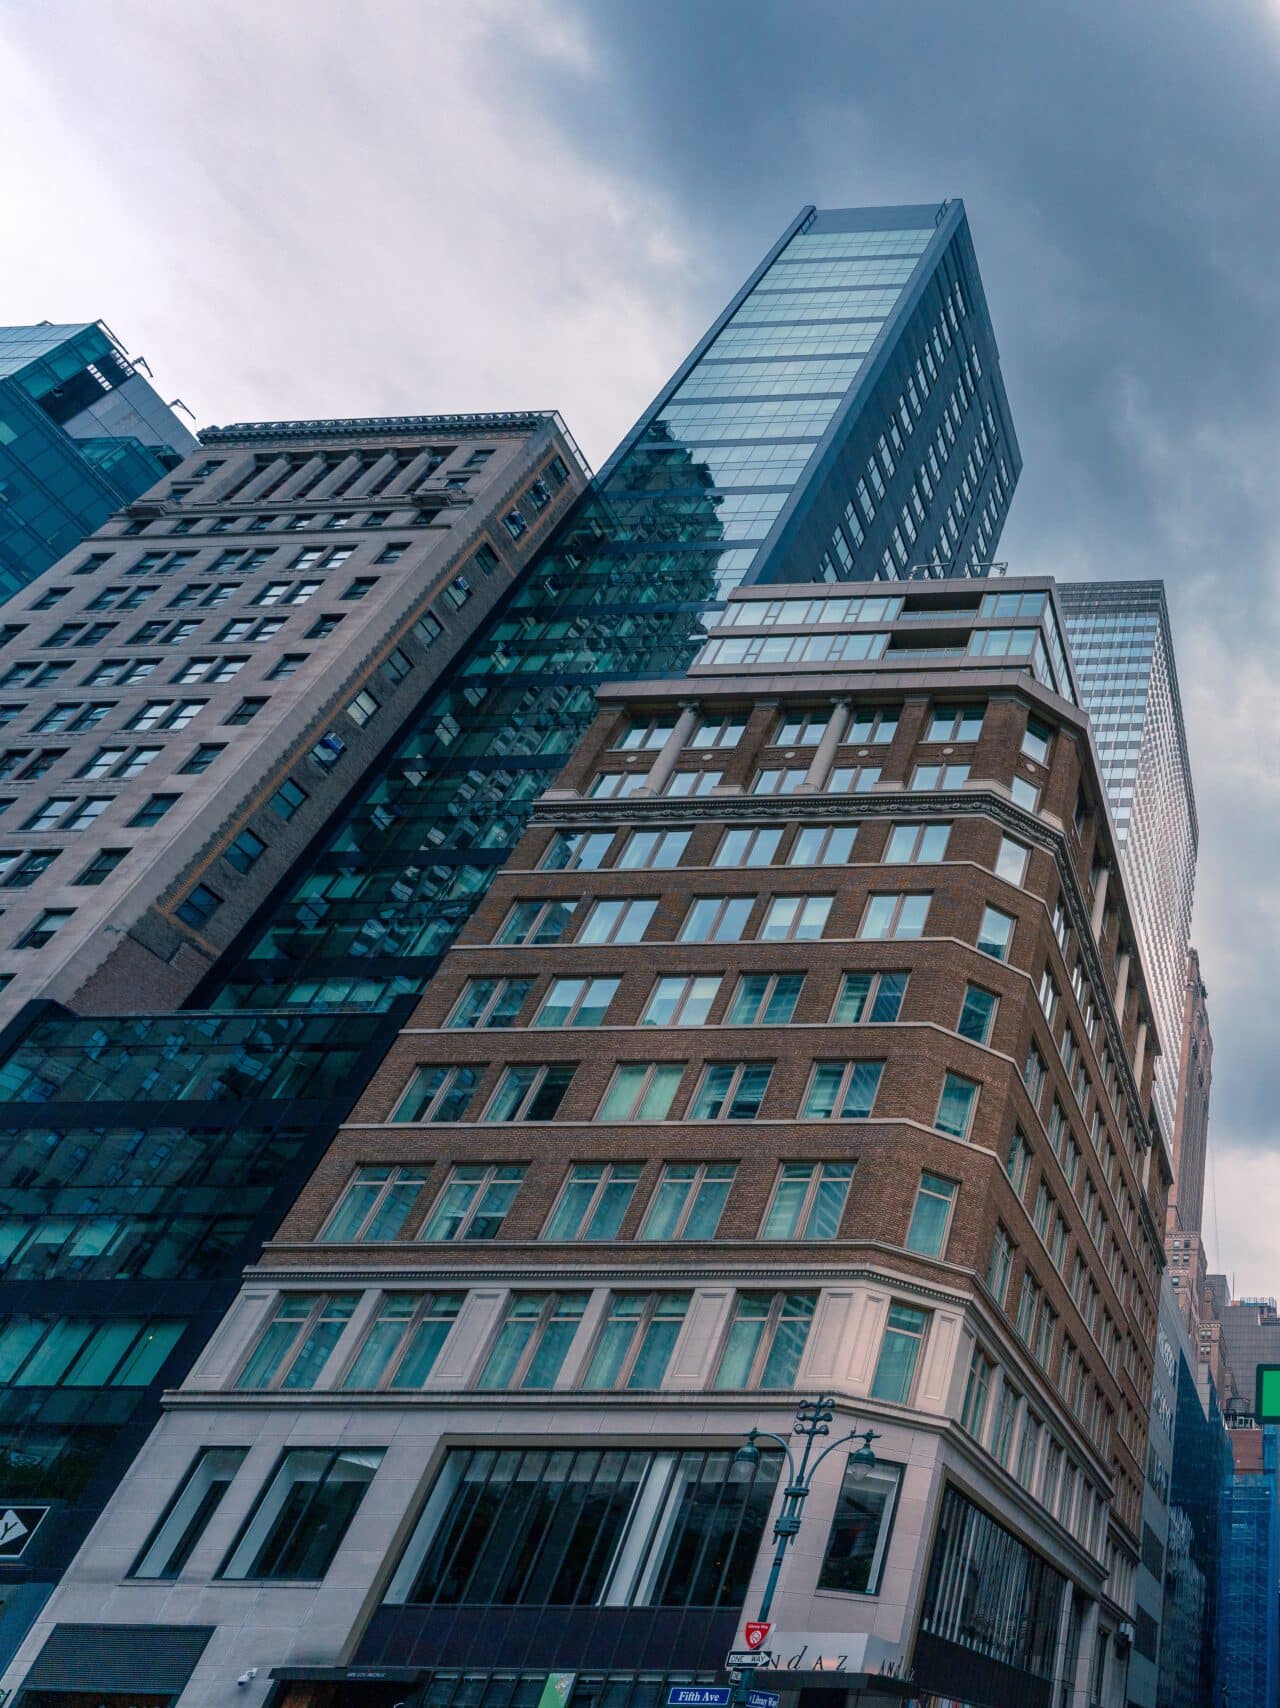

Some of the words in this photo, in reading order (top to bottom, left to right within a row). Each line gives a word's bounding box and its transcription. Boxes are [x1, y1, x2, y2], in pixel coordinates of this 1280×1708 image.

[731, 1655, 744, 1663] ONE
[751, 1655, 766, 1663] WAY
[678, 1691, 701, 1702] Fifth
[702, 1691, 720, 1702] Ave
[752, 1694, 768, 1708] Library
